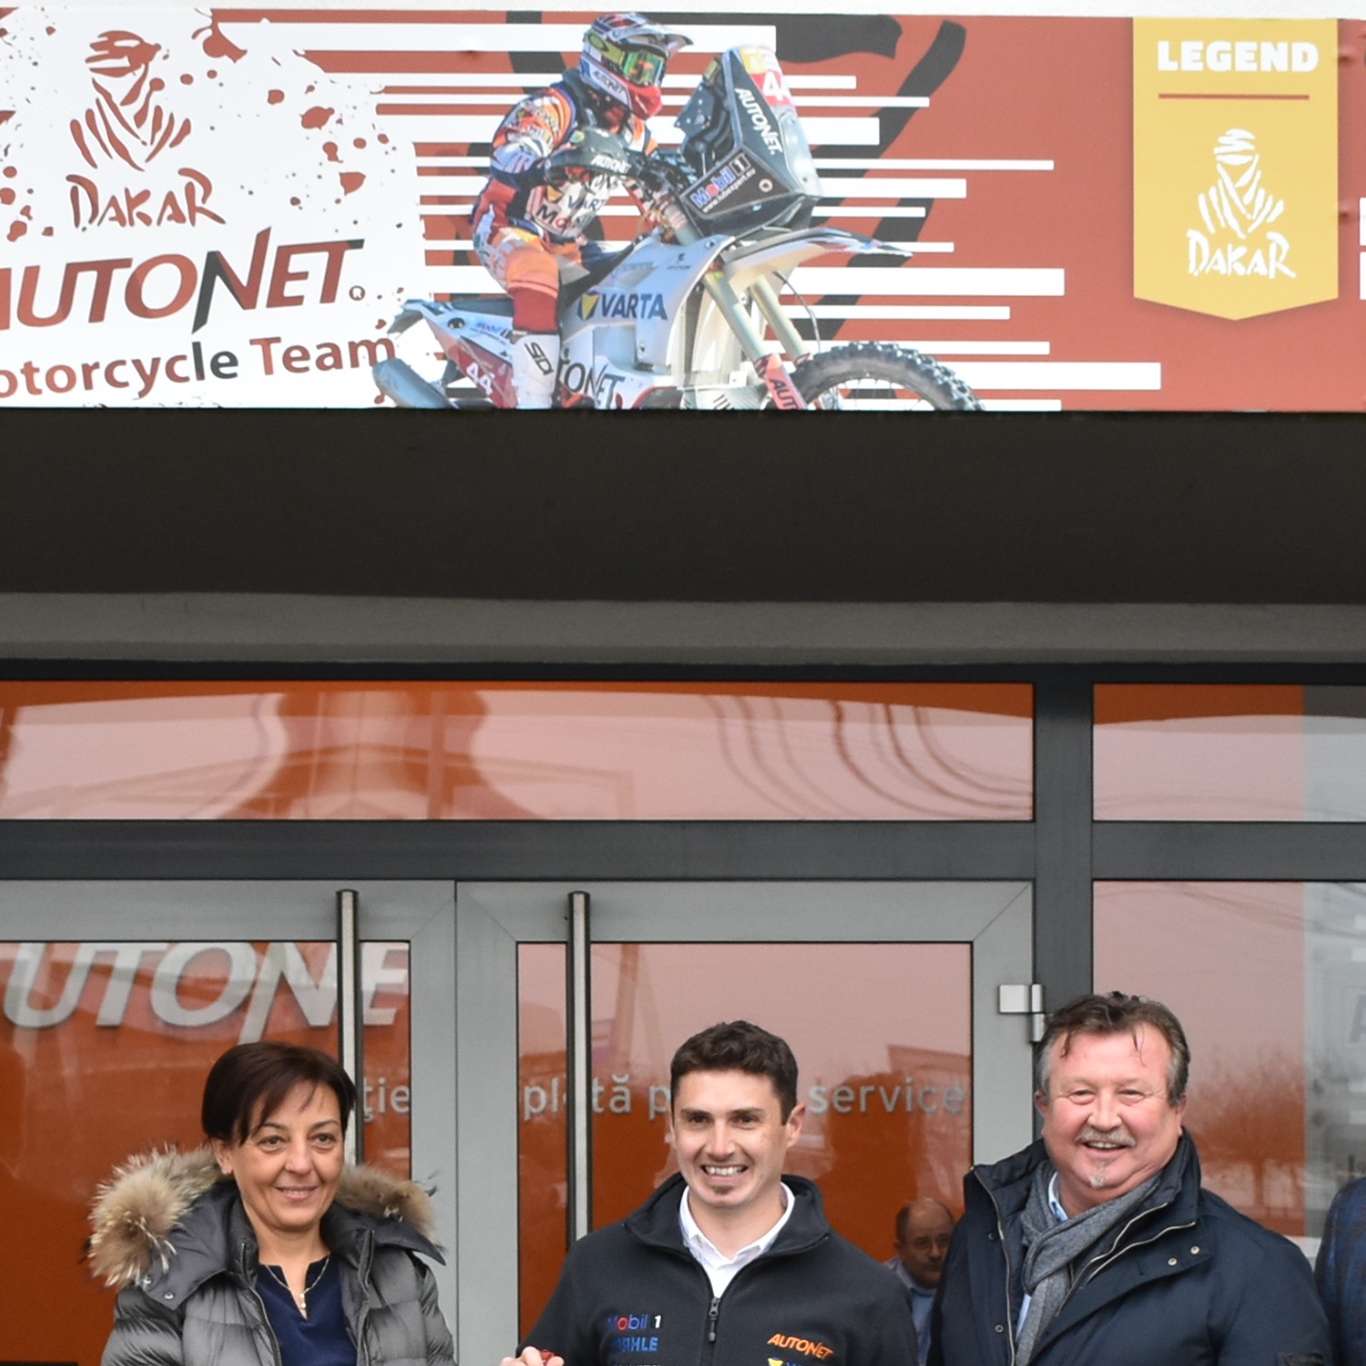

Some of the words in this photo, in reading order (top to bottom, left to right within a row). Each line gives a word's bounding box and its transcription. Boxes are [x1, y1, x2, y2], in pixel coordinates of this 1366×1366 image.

[1157, 40, 1319, 73] LEGEND
[66, 167, 226, 228] DAKAR
[1186, 228, 1297, 280] DAKAR
[601, 293, 668, 321] VARTA
[250, 336, 396, 377] Team
[807, 1074, 966, 1114] service
[654, 1314, 662, 1329] 1
[767, 1333, 834, 1360] AUTONET
